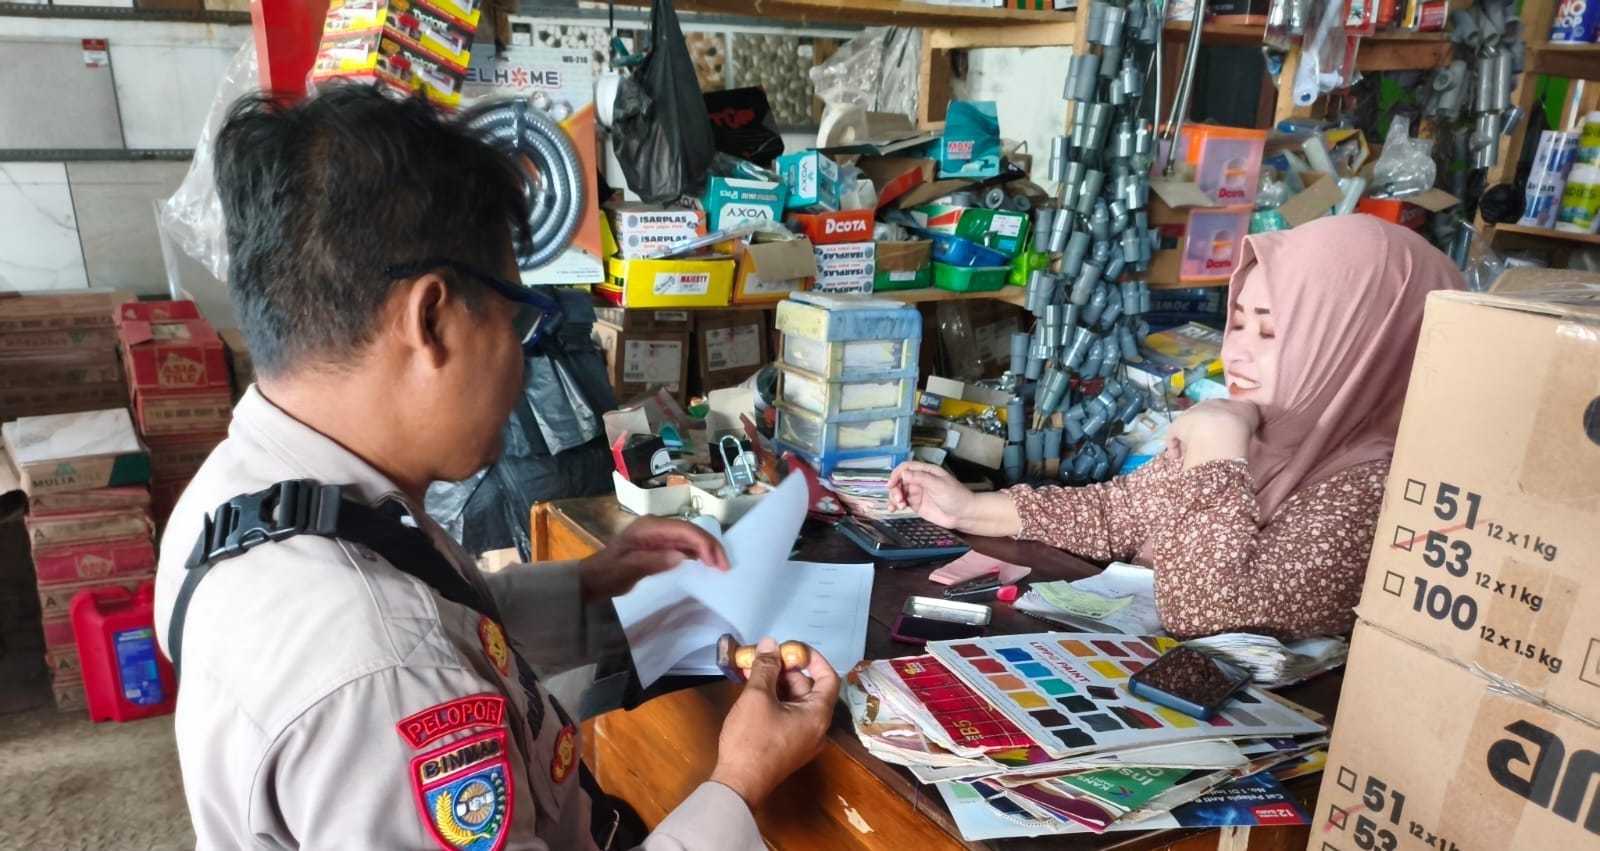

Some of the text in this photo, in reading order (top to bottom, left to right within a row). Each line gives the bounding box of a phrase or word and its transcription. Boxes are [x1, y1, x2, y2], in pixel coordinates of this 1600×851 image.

[466, 67, 559, 85] ELHOME
[640, 215, 687, 223] ISARPLAS
[726, 207, 768, 220] VOXY
[33, 476, 76, 489] MULIA
[1433, 481, 1558, 562] 51 12 x 1 kg
[1422, 529, 1544, 612] 53 12 x 1 kg
[1412, 575, 1564, 675] 100 12 x 1.5 kg
[1056, 661, 1091, 682] PAINT
[407, 701, 498, 742] PELOPOR
[951, 719, 980, 736] B5
[1076, 775, 1111, 791] KANS
[1118, 767, 1153, 786] Ins
[1362, 775, 1406, 826] 51
[1409, 820, 1425, 840] 12
[1353, 813, 1399, 851] 53
